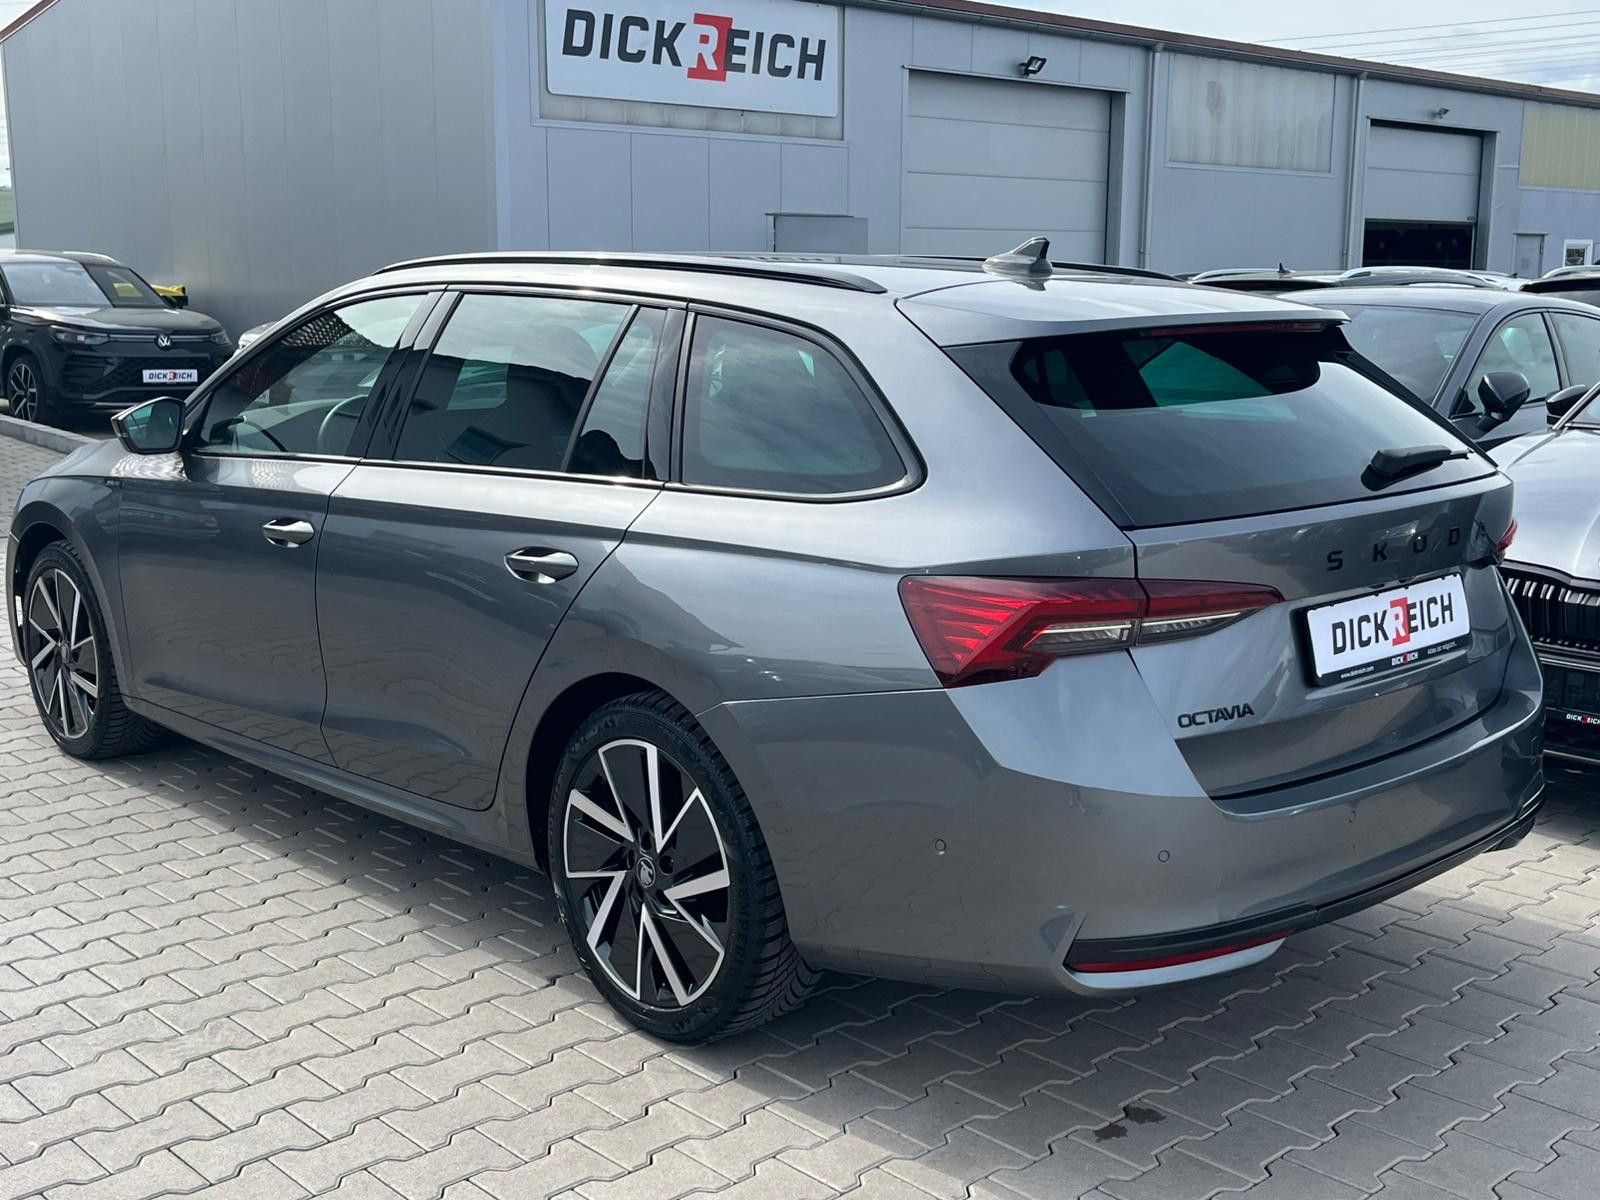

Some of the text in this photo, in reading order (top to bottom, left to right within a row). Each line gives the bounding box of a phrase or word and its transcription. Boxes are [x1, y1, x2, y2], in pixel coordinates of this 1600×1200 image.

[562, 8, 826, 82] DICKREICH
[148, 370, 193, 382] DICKREICH
[1331, 592, 1454, 655] DICKREICH
[1177, 703, 1255, 728] OCTAVIA
